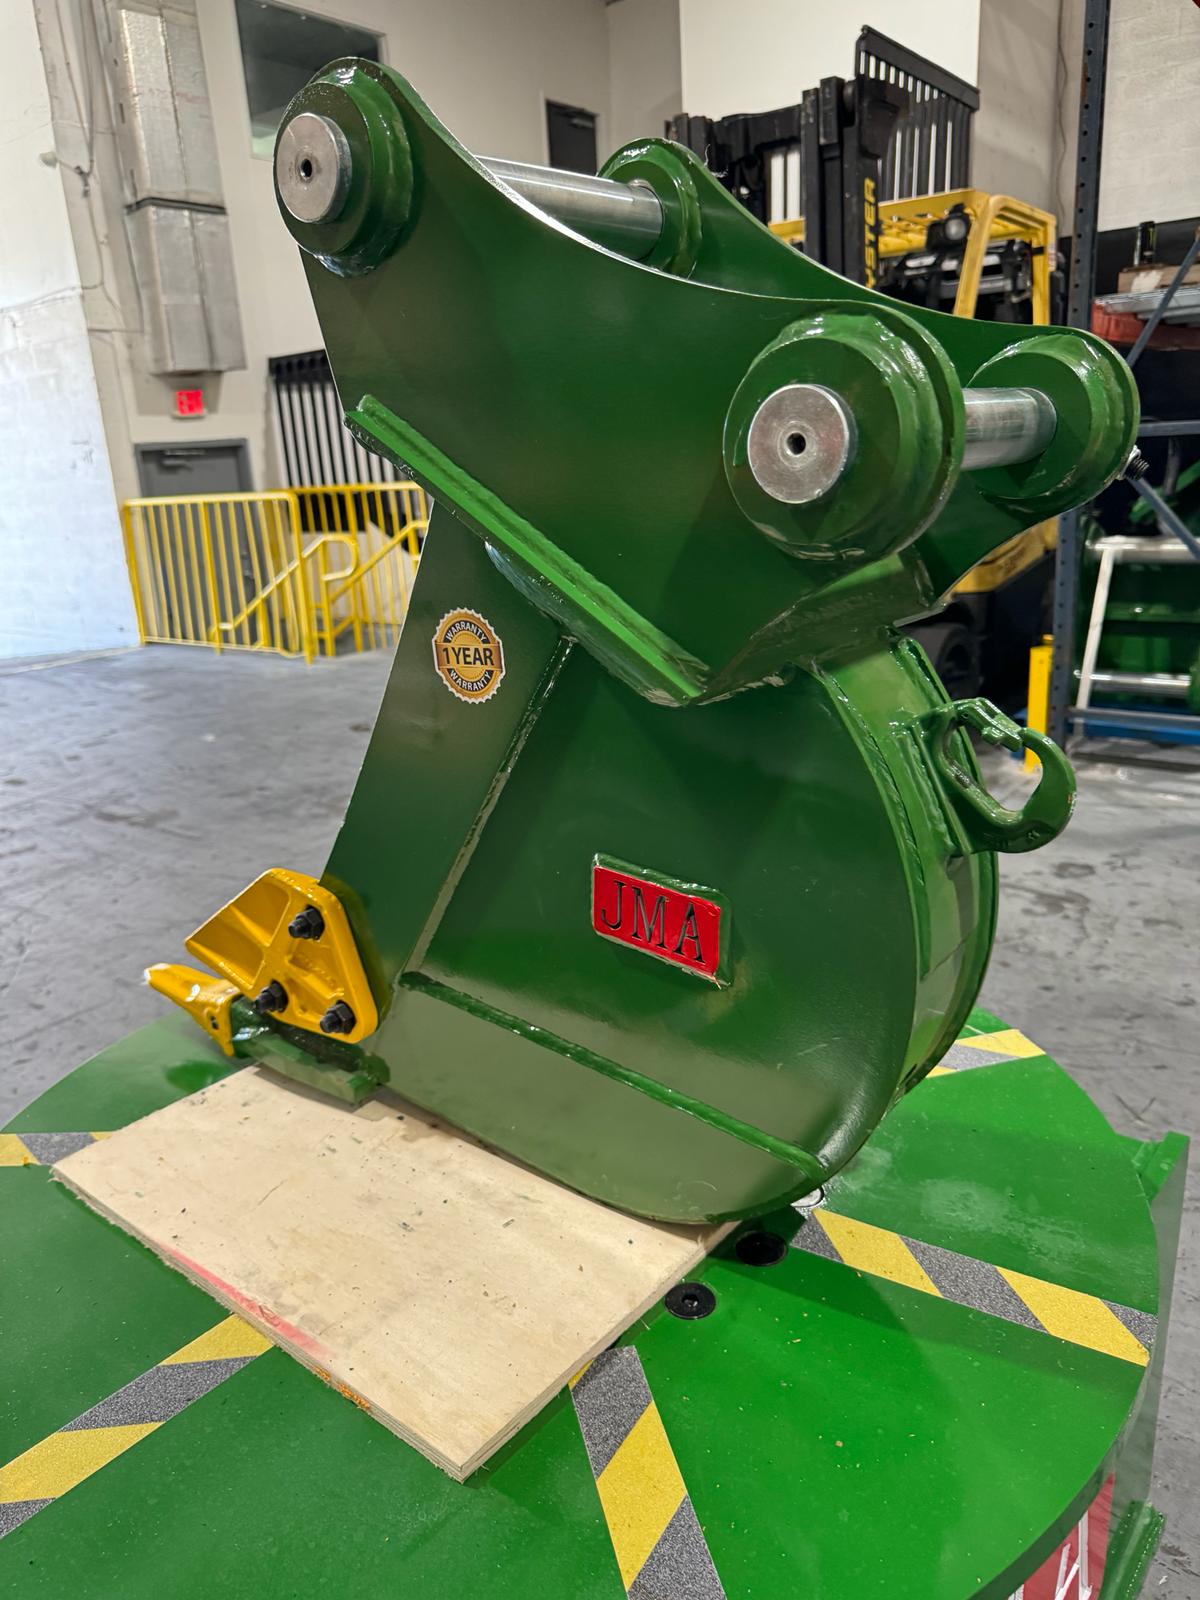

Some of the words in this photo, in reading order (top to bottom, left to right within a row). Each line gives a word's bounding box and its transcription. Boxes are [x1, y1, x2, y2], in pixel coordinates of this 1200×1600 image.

[864, 177, 876, 289] YSTER
[445, 621, 487, 641] WARRANTY
[442, 647, 451, 665] 1
[451, 647, 495, 666] YEAR
[450, 671, 492, 692] WARRANTY
[601, 880, 706, 965] JMA
